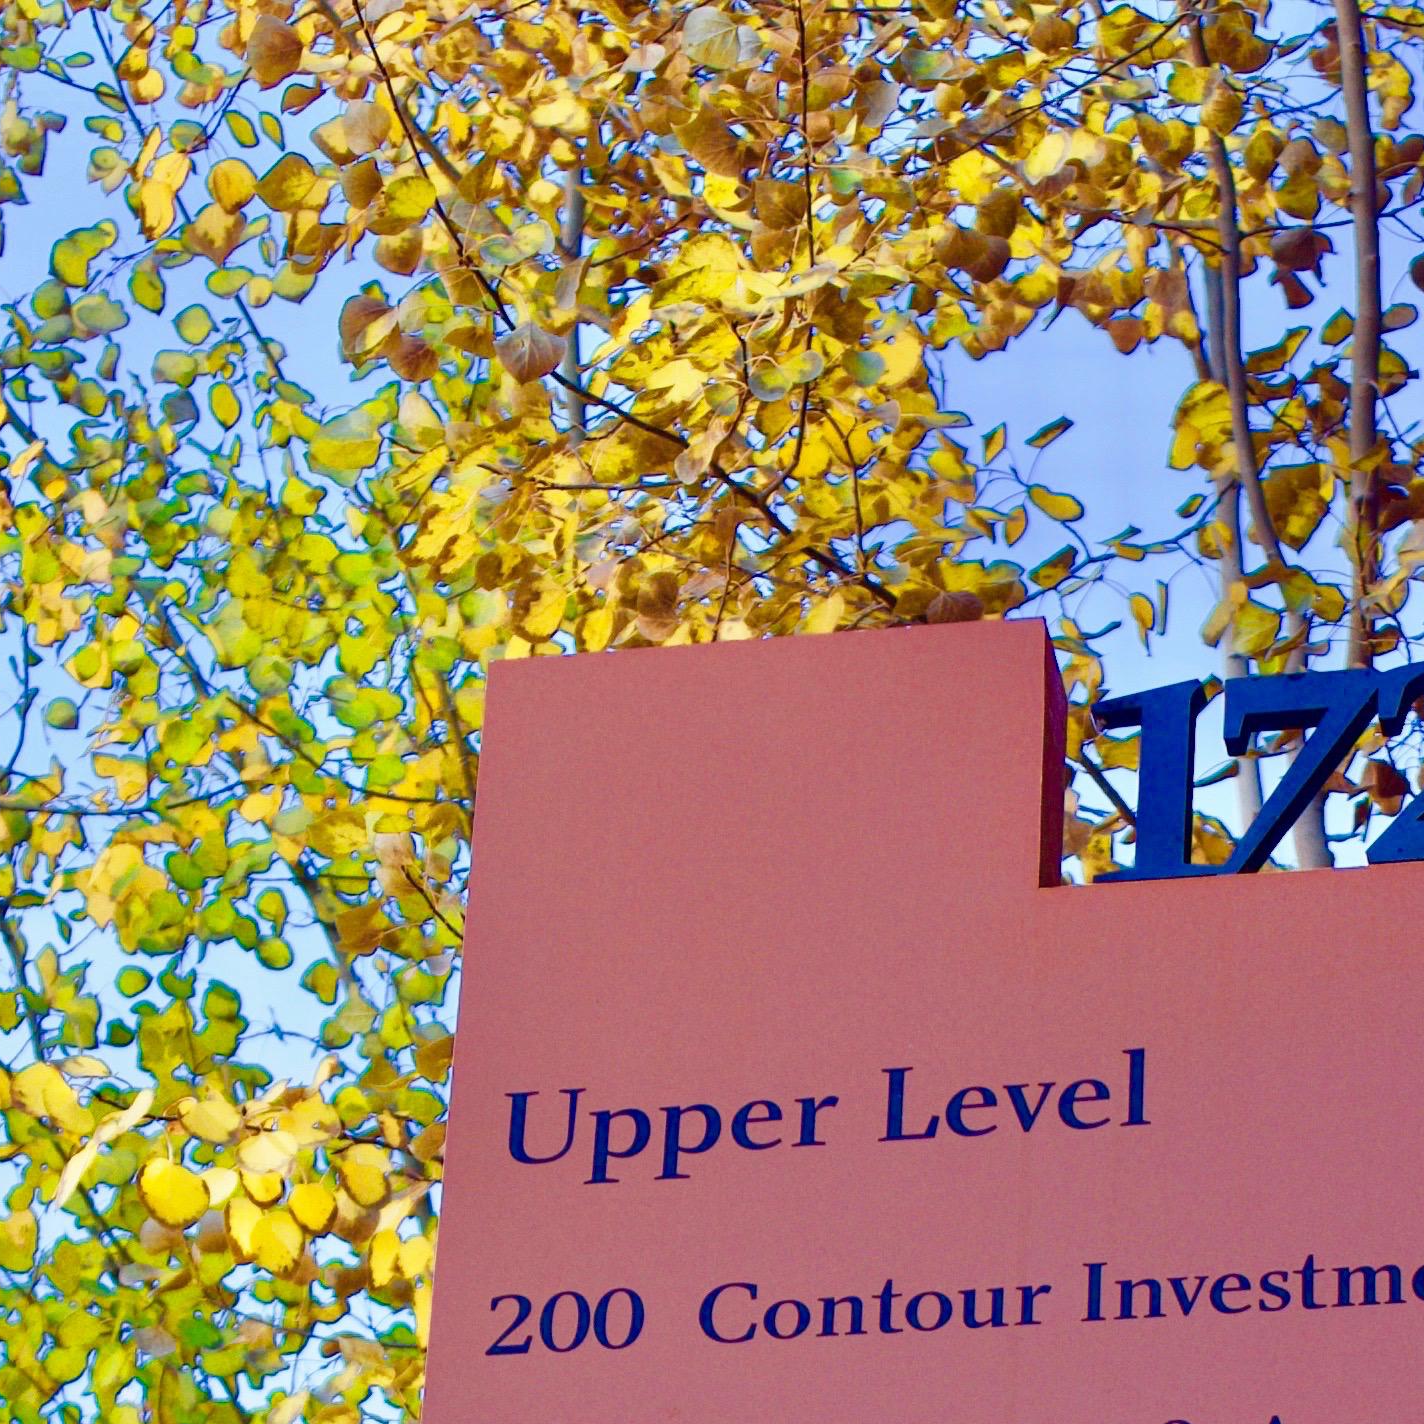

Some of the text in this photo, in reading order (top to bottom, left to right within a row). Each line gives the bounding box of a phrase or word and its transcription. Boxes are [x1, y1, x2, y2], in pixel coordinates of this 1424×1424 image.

[505, 1048, 1151, 1184] Upper Level
[485, 1288, 644, 1356] 200
[699, 1279, 1052, 1343] Contour
